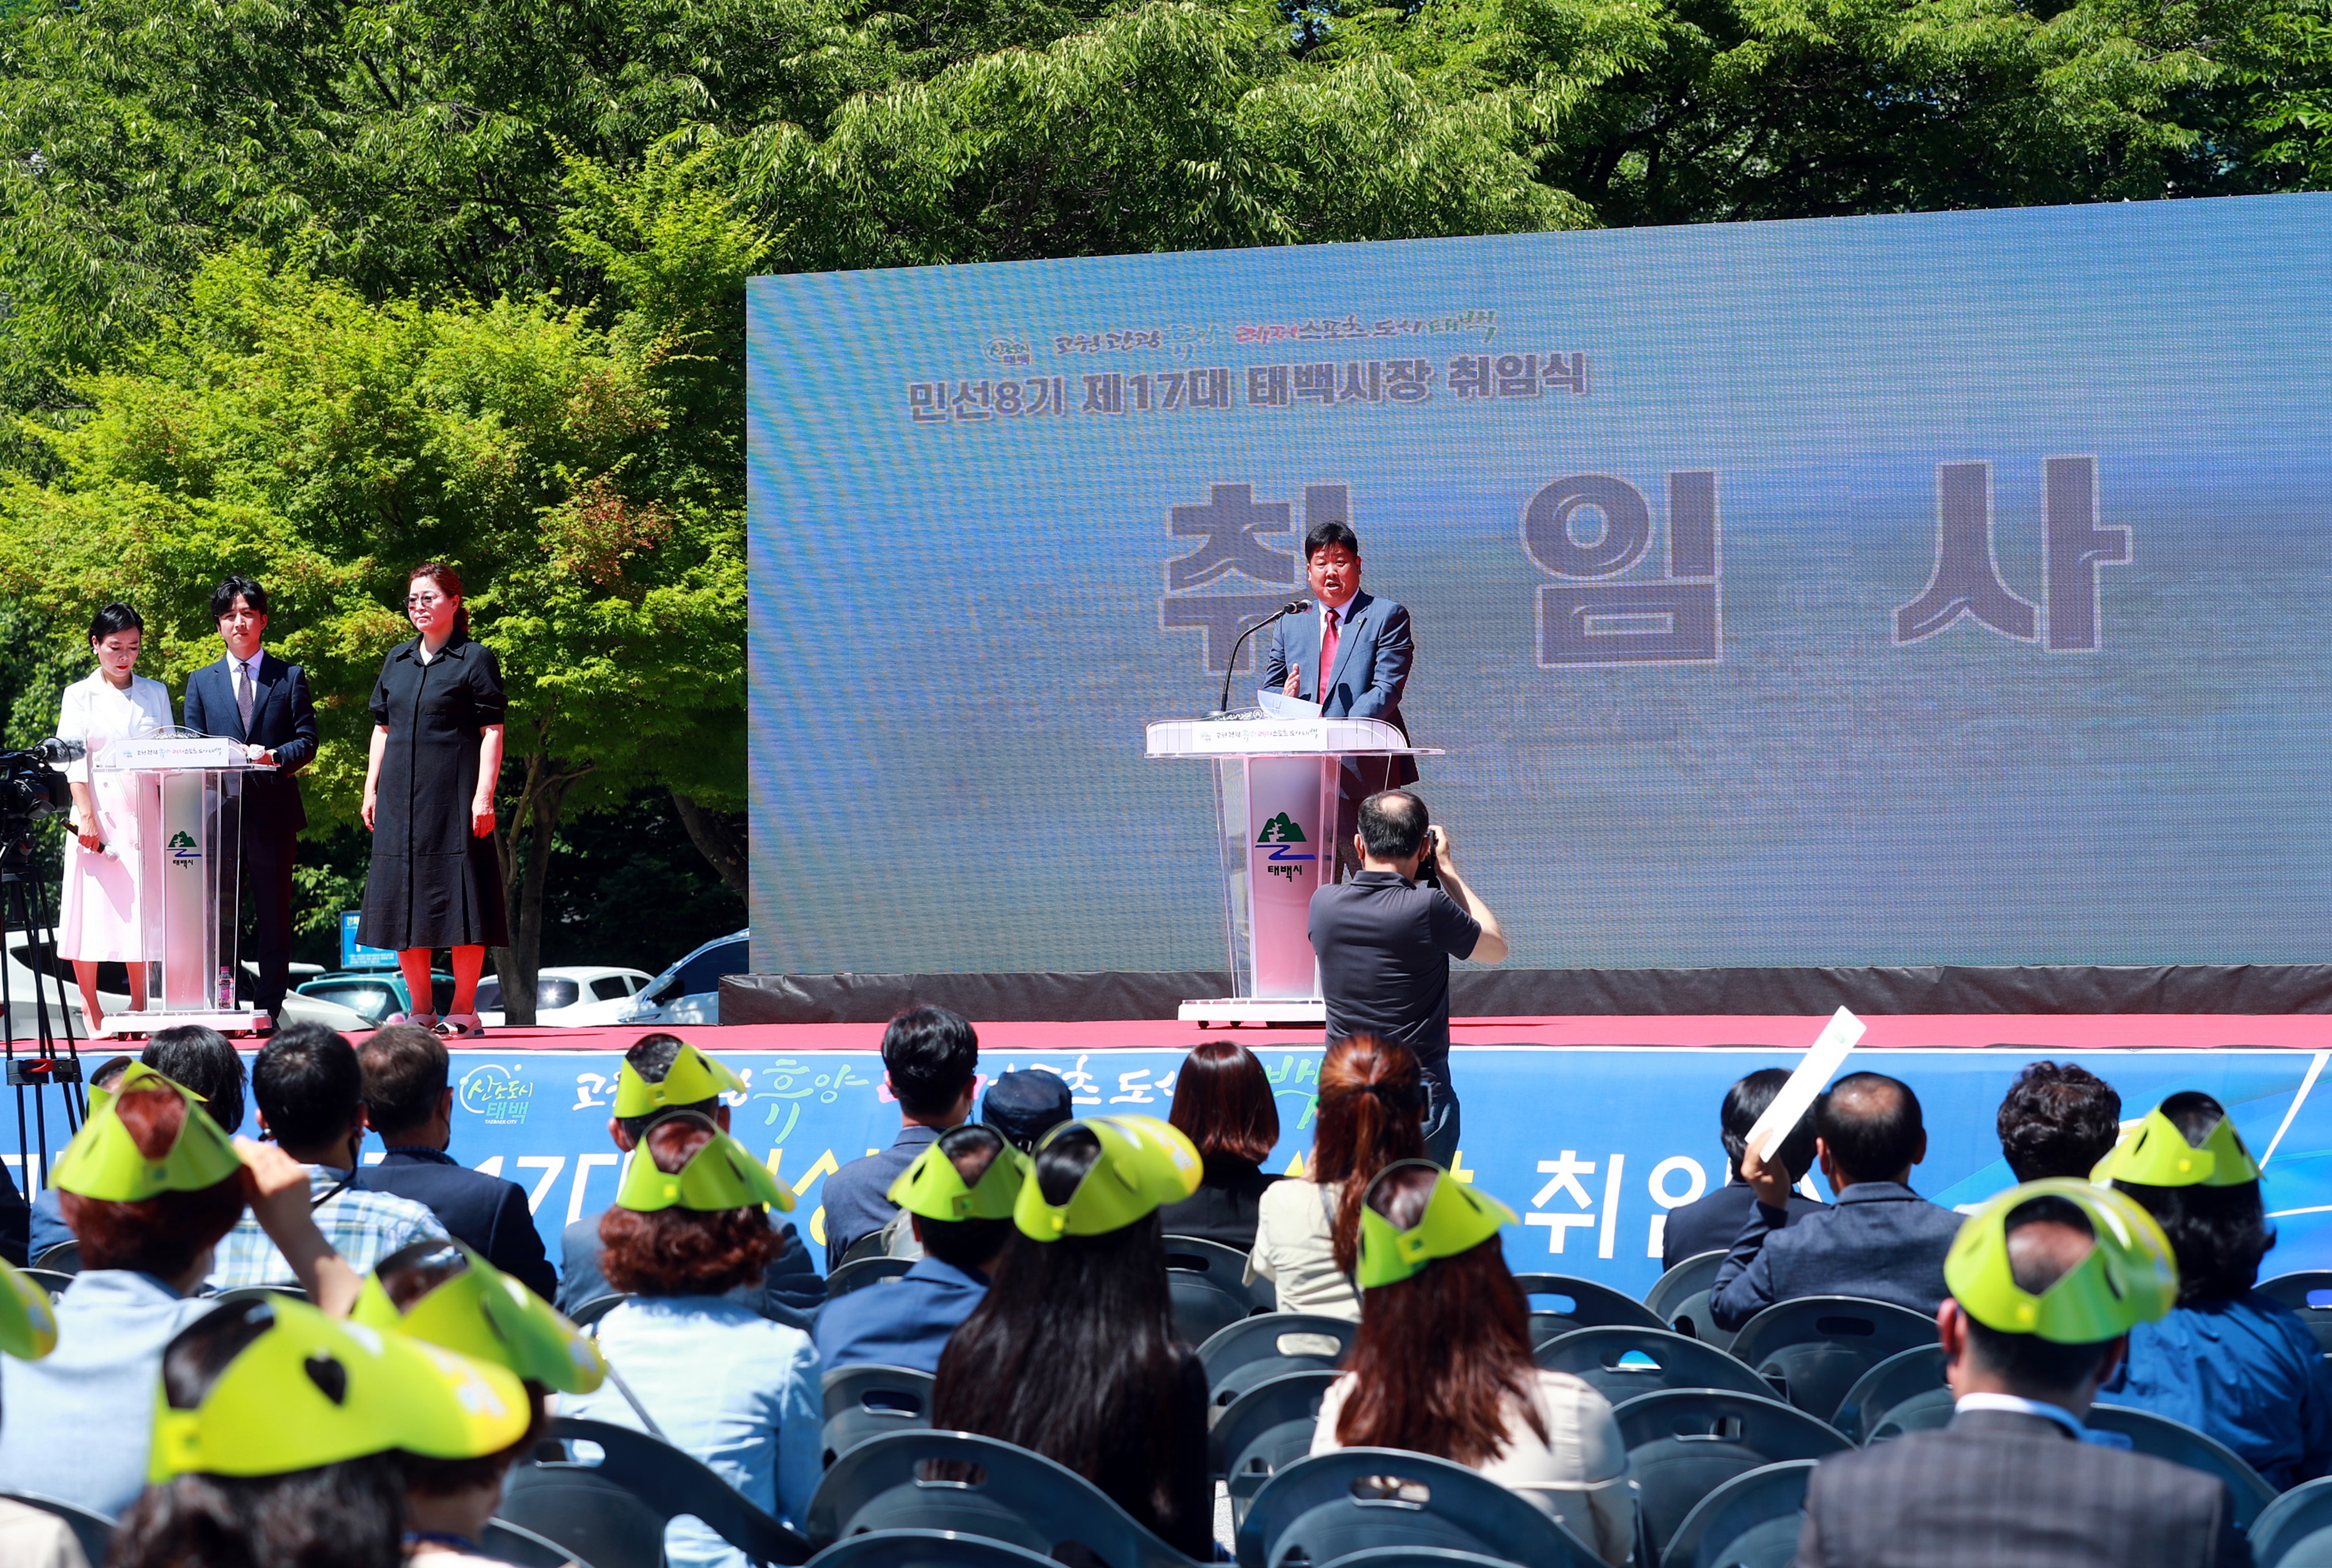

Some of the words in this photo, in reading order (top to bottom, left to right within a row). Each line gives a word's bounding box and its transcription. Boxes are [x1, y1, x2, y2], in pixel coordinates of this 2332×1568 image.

[909, 376, 1065, 422] 민선8기
[1082, 367, 1231, 413] 제17대
[1247, 359, 1433, 405] 태백시장
[1448, 352, 1586, 397] 취임식
[172, 859, 193, 869] 태백시
[1268, 865, 1302, 883] 태백시
[467, 1074, 533, 1101] 산소도시
[486, 1101, 529, 1124] 태백
